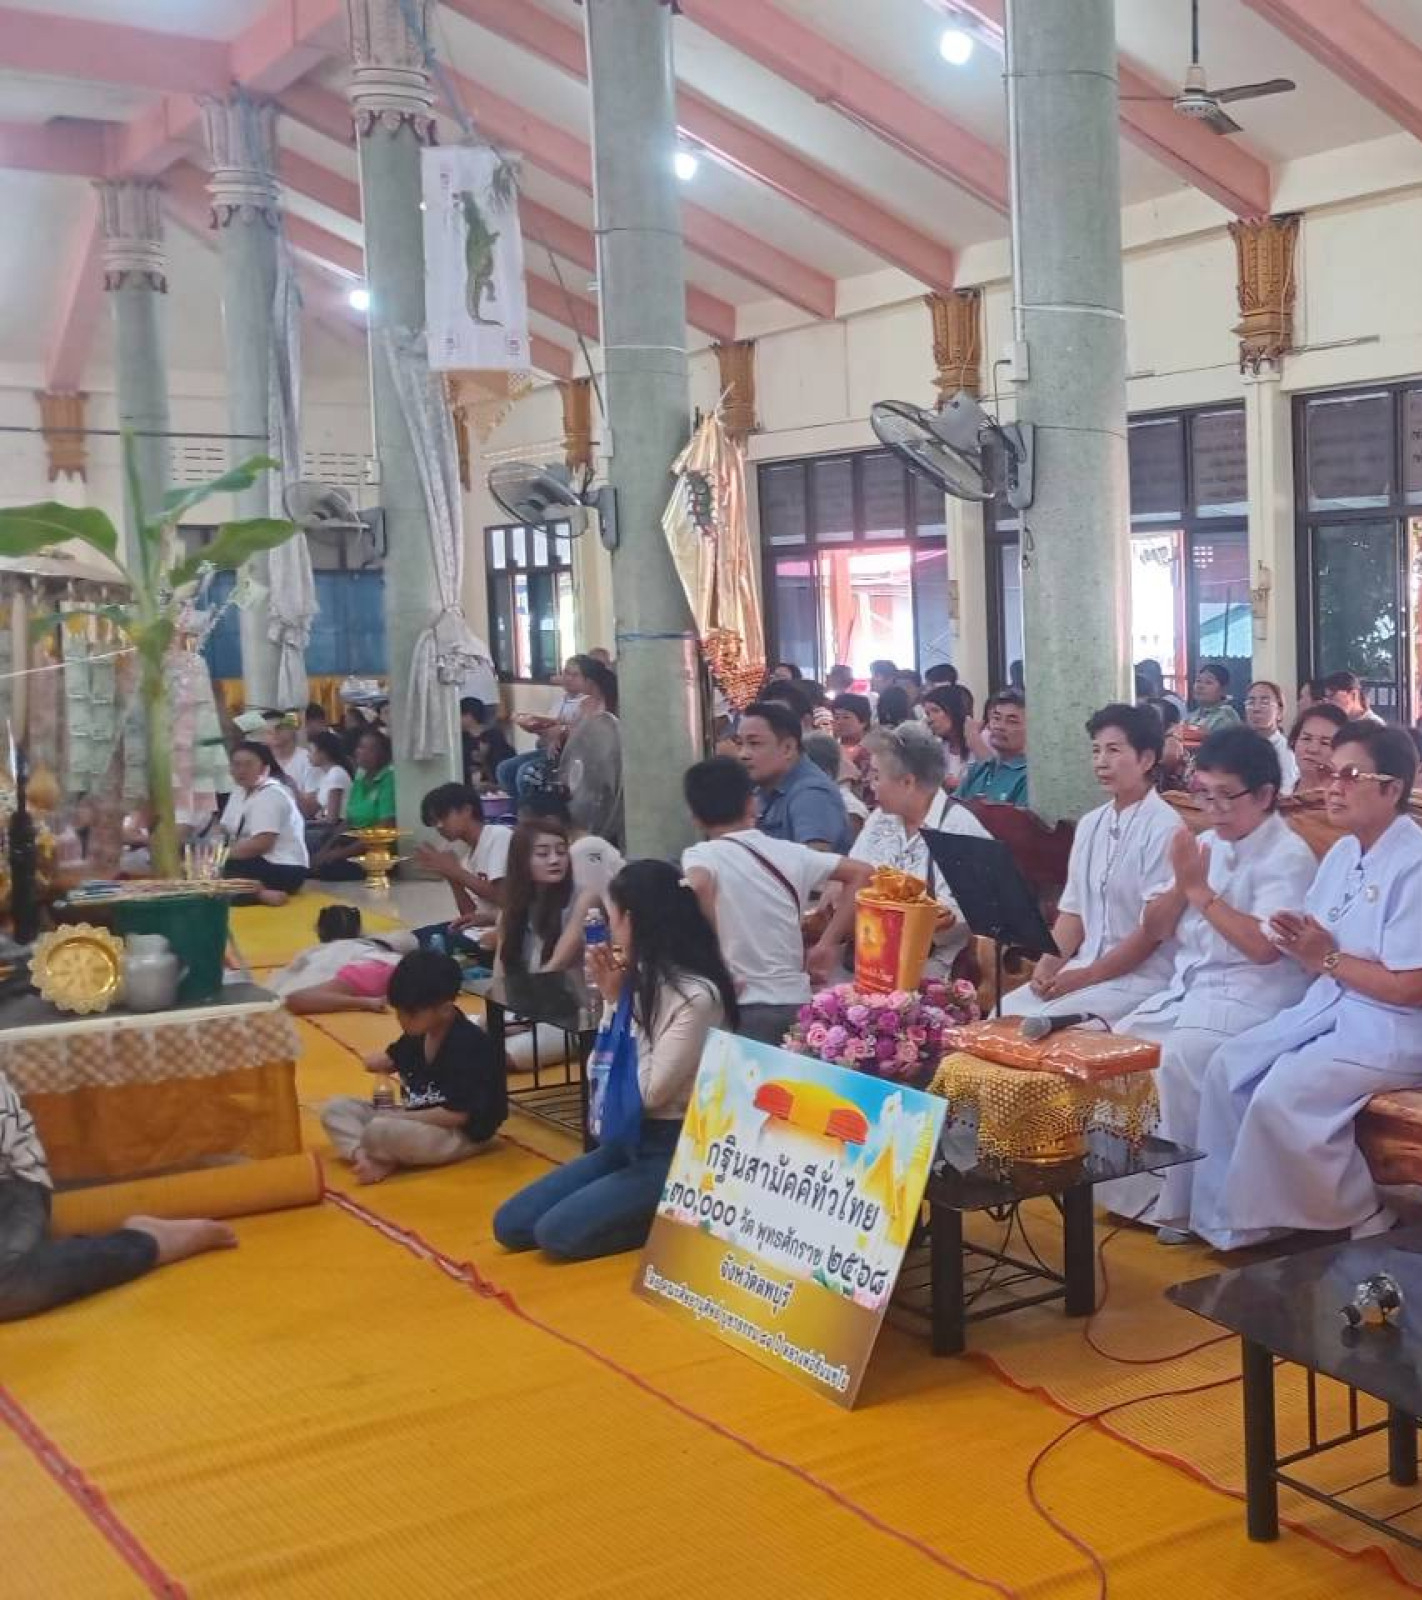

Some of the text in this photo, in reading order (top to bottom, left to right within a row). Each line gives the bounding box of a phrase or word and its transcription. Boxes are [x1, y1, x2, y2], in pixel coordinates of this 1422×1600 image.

[706, 1134, 881, 1232] กฐินสามัคคีทั่วไทย
[720, 1253, 794, 1316] จังหวัดลพบุรี
[740, 1207, 756, 1236] วัด
[756, 1221, 824, 1266] พุทธศักราช
[827, 1244, 889, 1296] ๒๕๖๘
